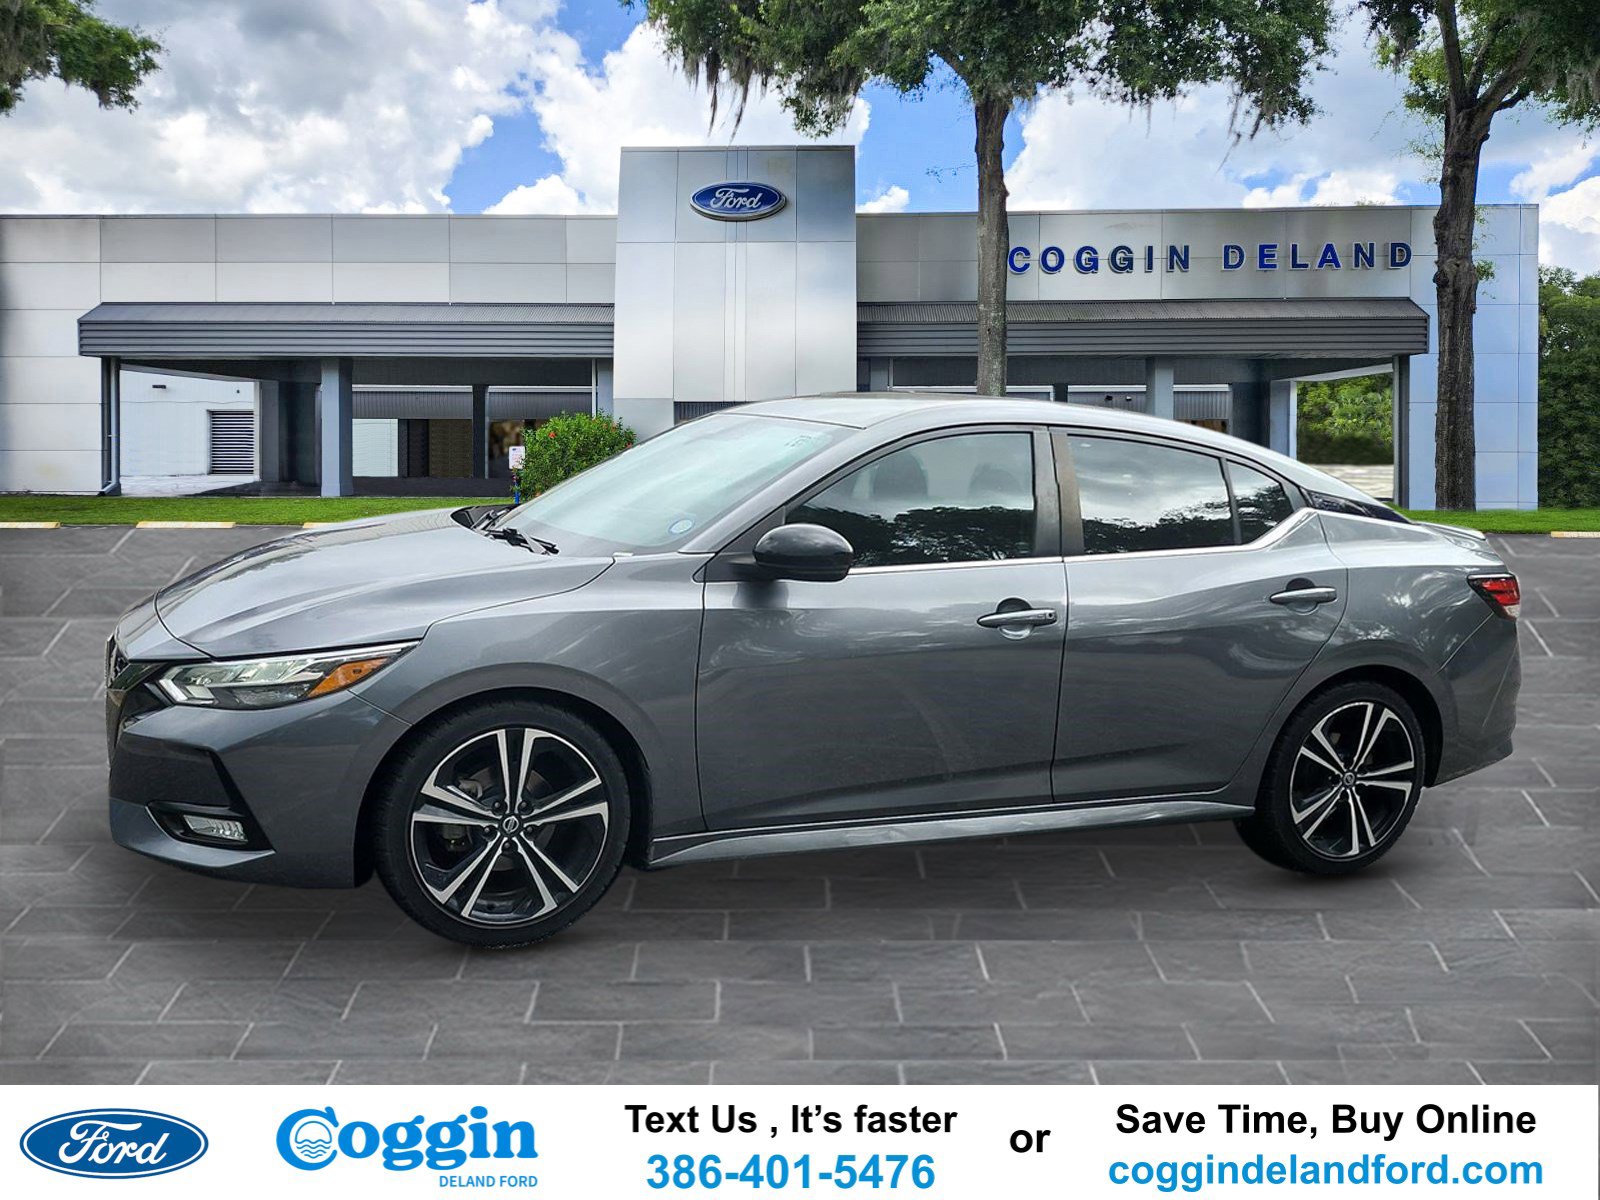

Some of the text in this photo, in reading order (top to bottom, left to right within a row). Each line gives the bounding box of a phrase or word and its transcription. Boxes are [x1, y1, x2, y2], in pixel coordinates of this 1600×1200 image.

[710, 187, 763, 209] Ford
[1007, 241, 1413, 275] COGGIN DELAND
